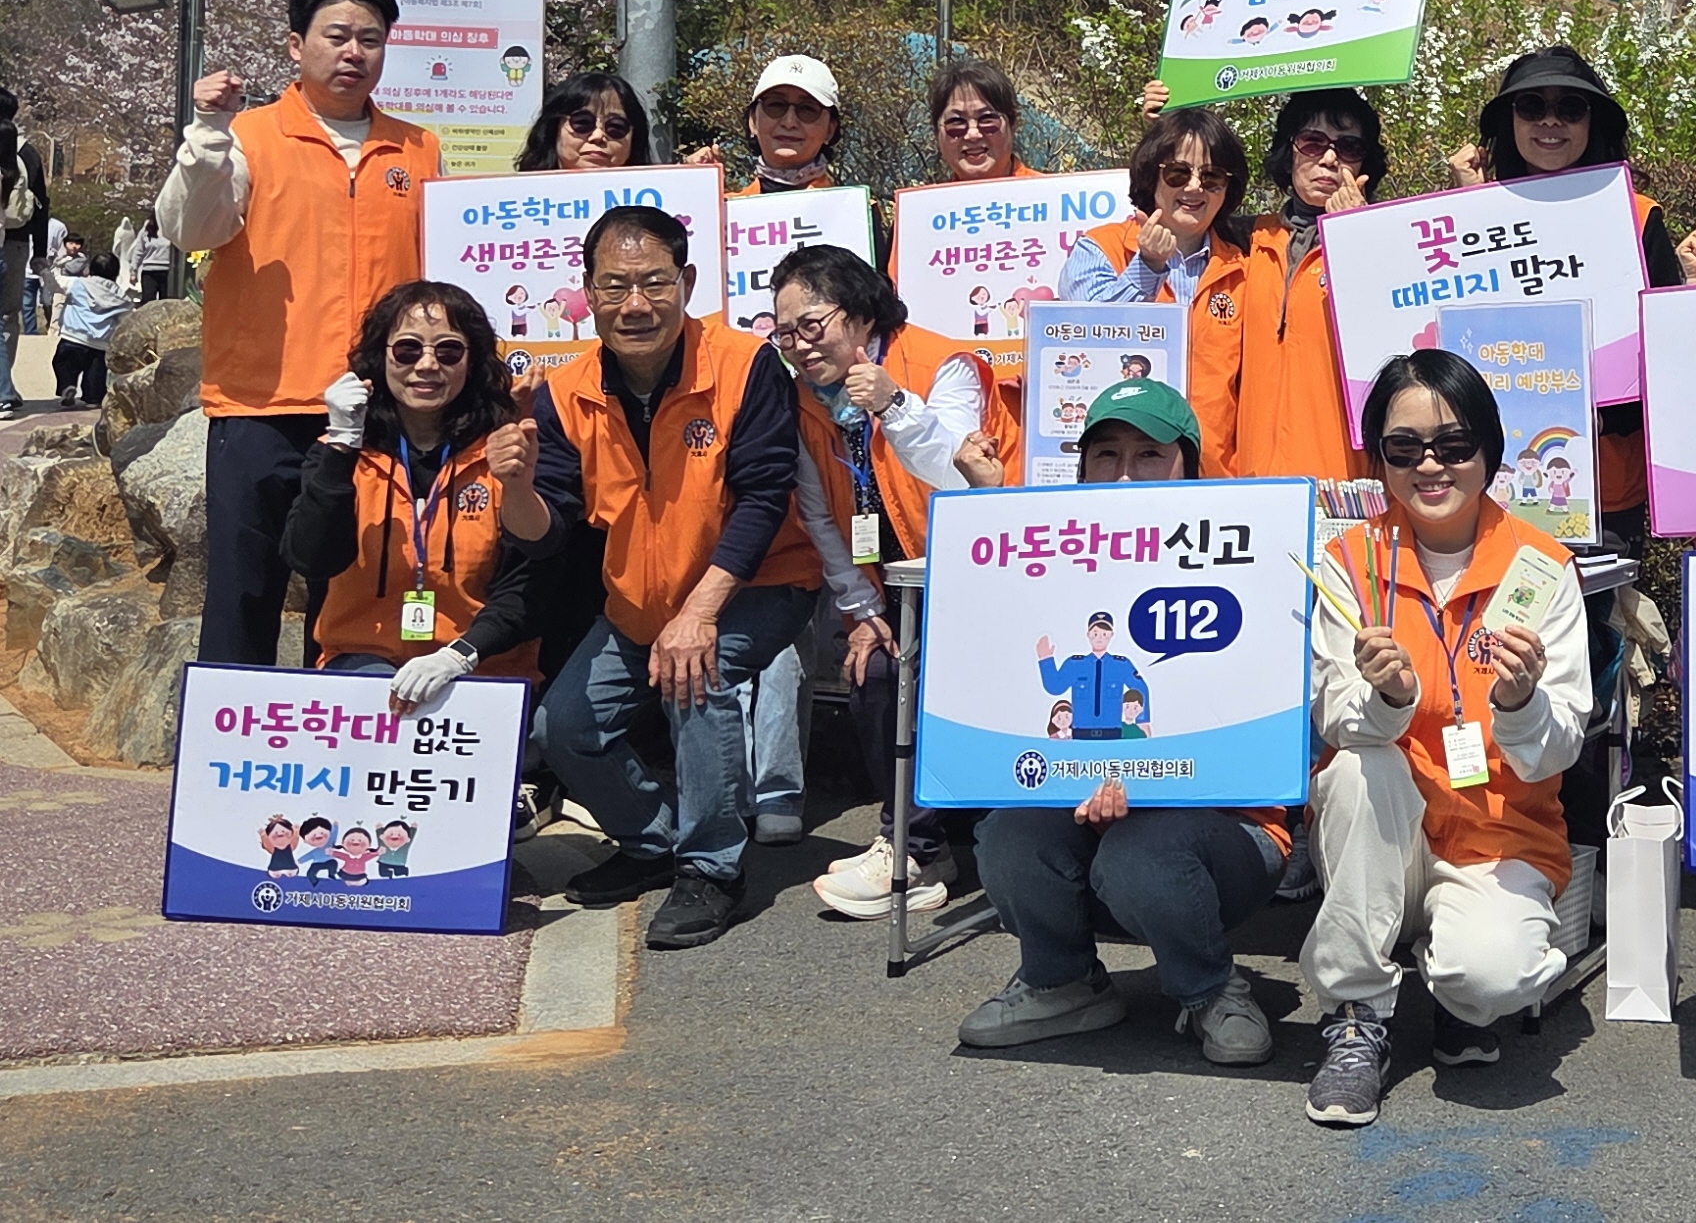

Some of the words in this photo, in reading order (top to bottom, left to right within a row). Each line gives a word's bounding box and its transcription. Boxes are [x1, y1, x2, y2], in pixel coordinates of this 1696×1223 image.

[390, 28, 437, 42] 아동학대
[440, 31, 463, 43] 의심
[467, 32, 489, 44] 징후
[462, 197, 590, 231] 아동학대
[932, 201, 1048, 235] 아동학대
[1061, 190, 1116, 222] NO
[460, 236, 585, 273] 생명존중
[928, 238, 1047, 276] 생명존중
[1411, 215, 1538, 274] 꽃으로도
[1392, 268, 1500, 309] 때리지
[1510, 254, 1584, 296] 말자
[1045, 324, 1086, 341] 아동의
[1092, 325, 1130, 340] 4가지
[1137, 326, 1166, 342] 권리
[1480, 342, 1544, 365] 아동학대
[1517, 370, 1581, 393] 예방부스
[971, 519, 1255, 578] 아동학대신고
[1148, 599, 1219, 640] 112
[214, 700, 400, 749] 아동학대
[413, 717, 481, 756] 없는
[209, 760, 351, 797] 거제시
[367, 769, 476, 811] 만들기
[1051, 759, 1194, 780] 거제시아동위원협의회
[285, 892, 411, 911] 거제시아동위원협의회
